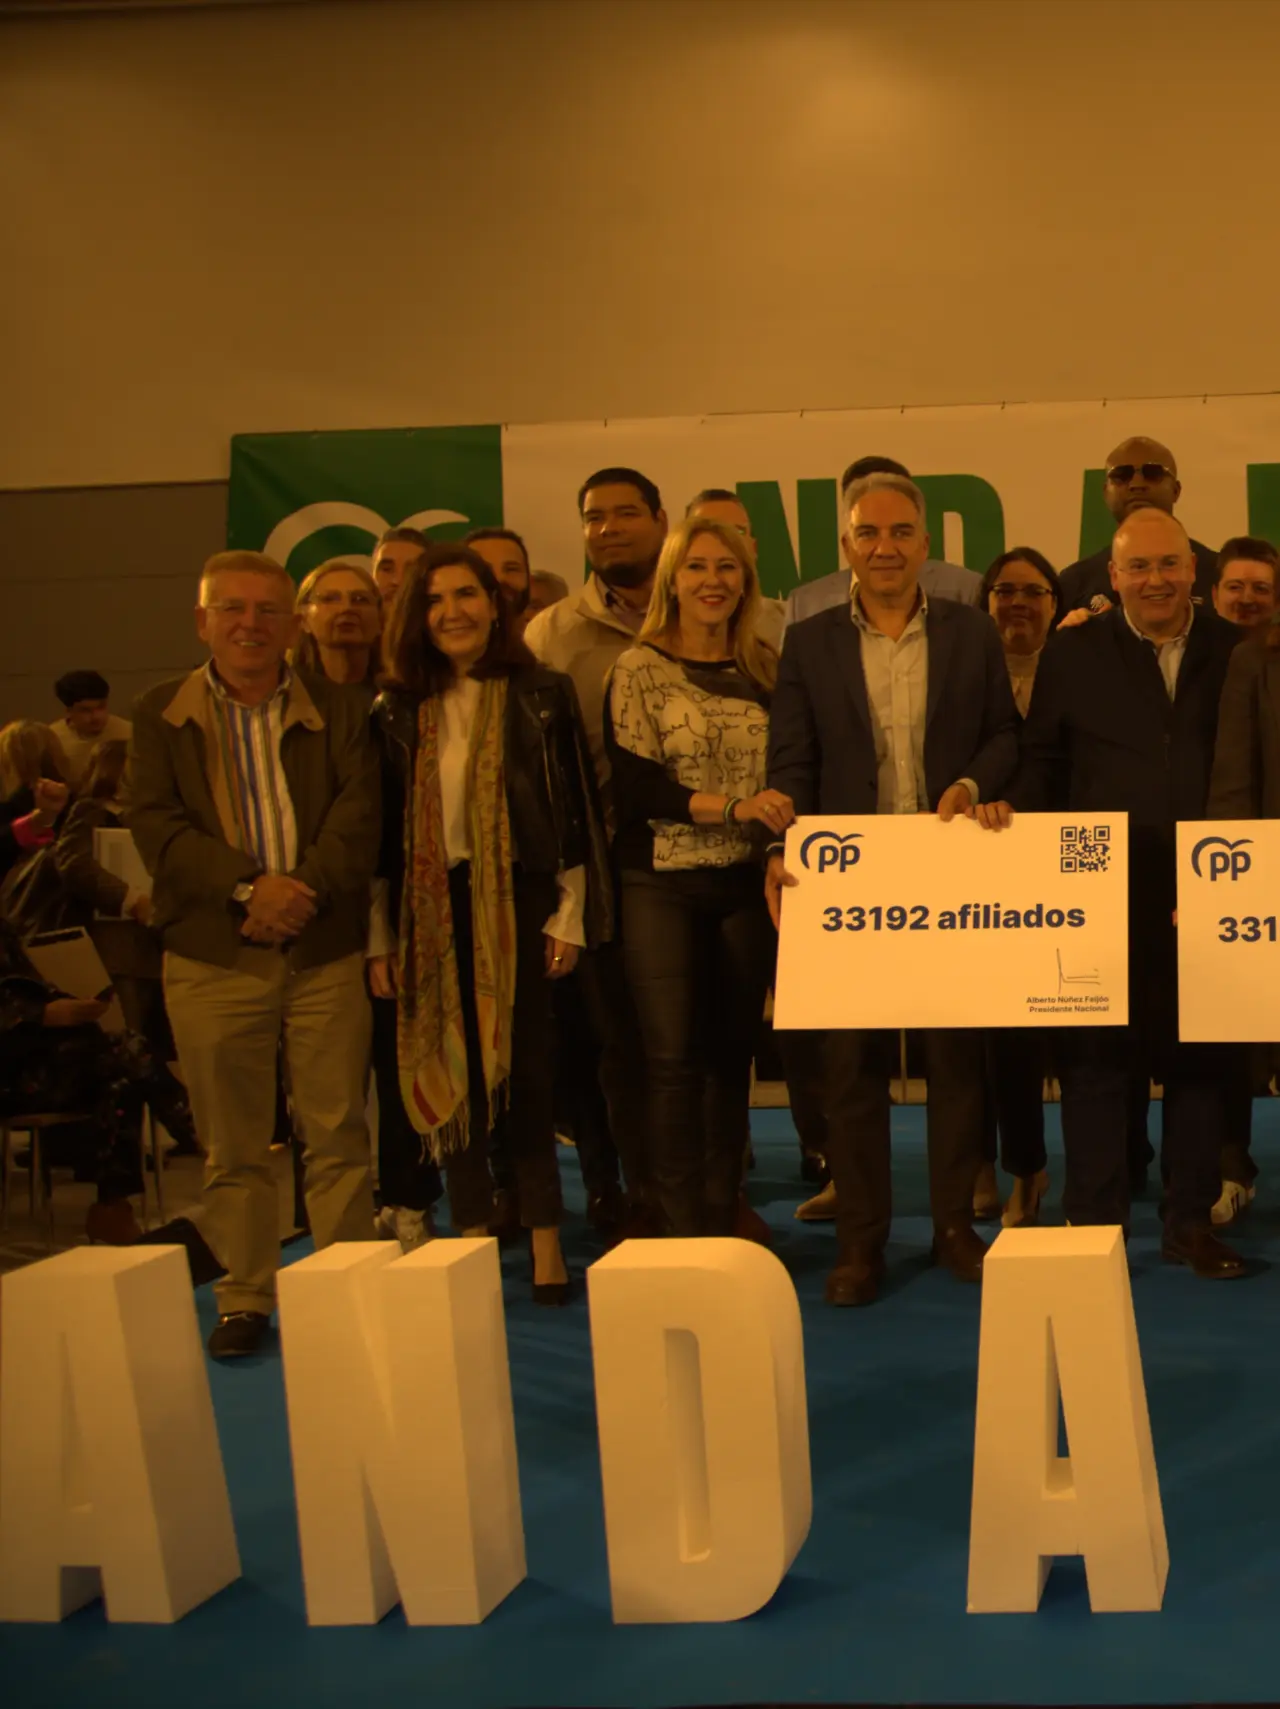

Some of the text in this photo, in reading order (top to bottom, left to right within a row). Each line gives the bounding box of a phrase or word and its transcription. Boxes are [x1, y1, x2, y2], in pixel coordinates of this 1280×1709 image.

[822, 902, 1086, 932] 33192 afiliados
[1026, 996, 1056, 1004] Alberto
